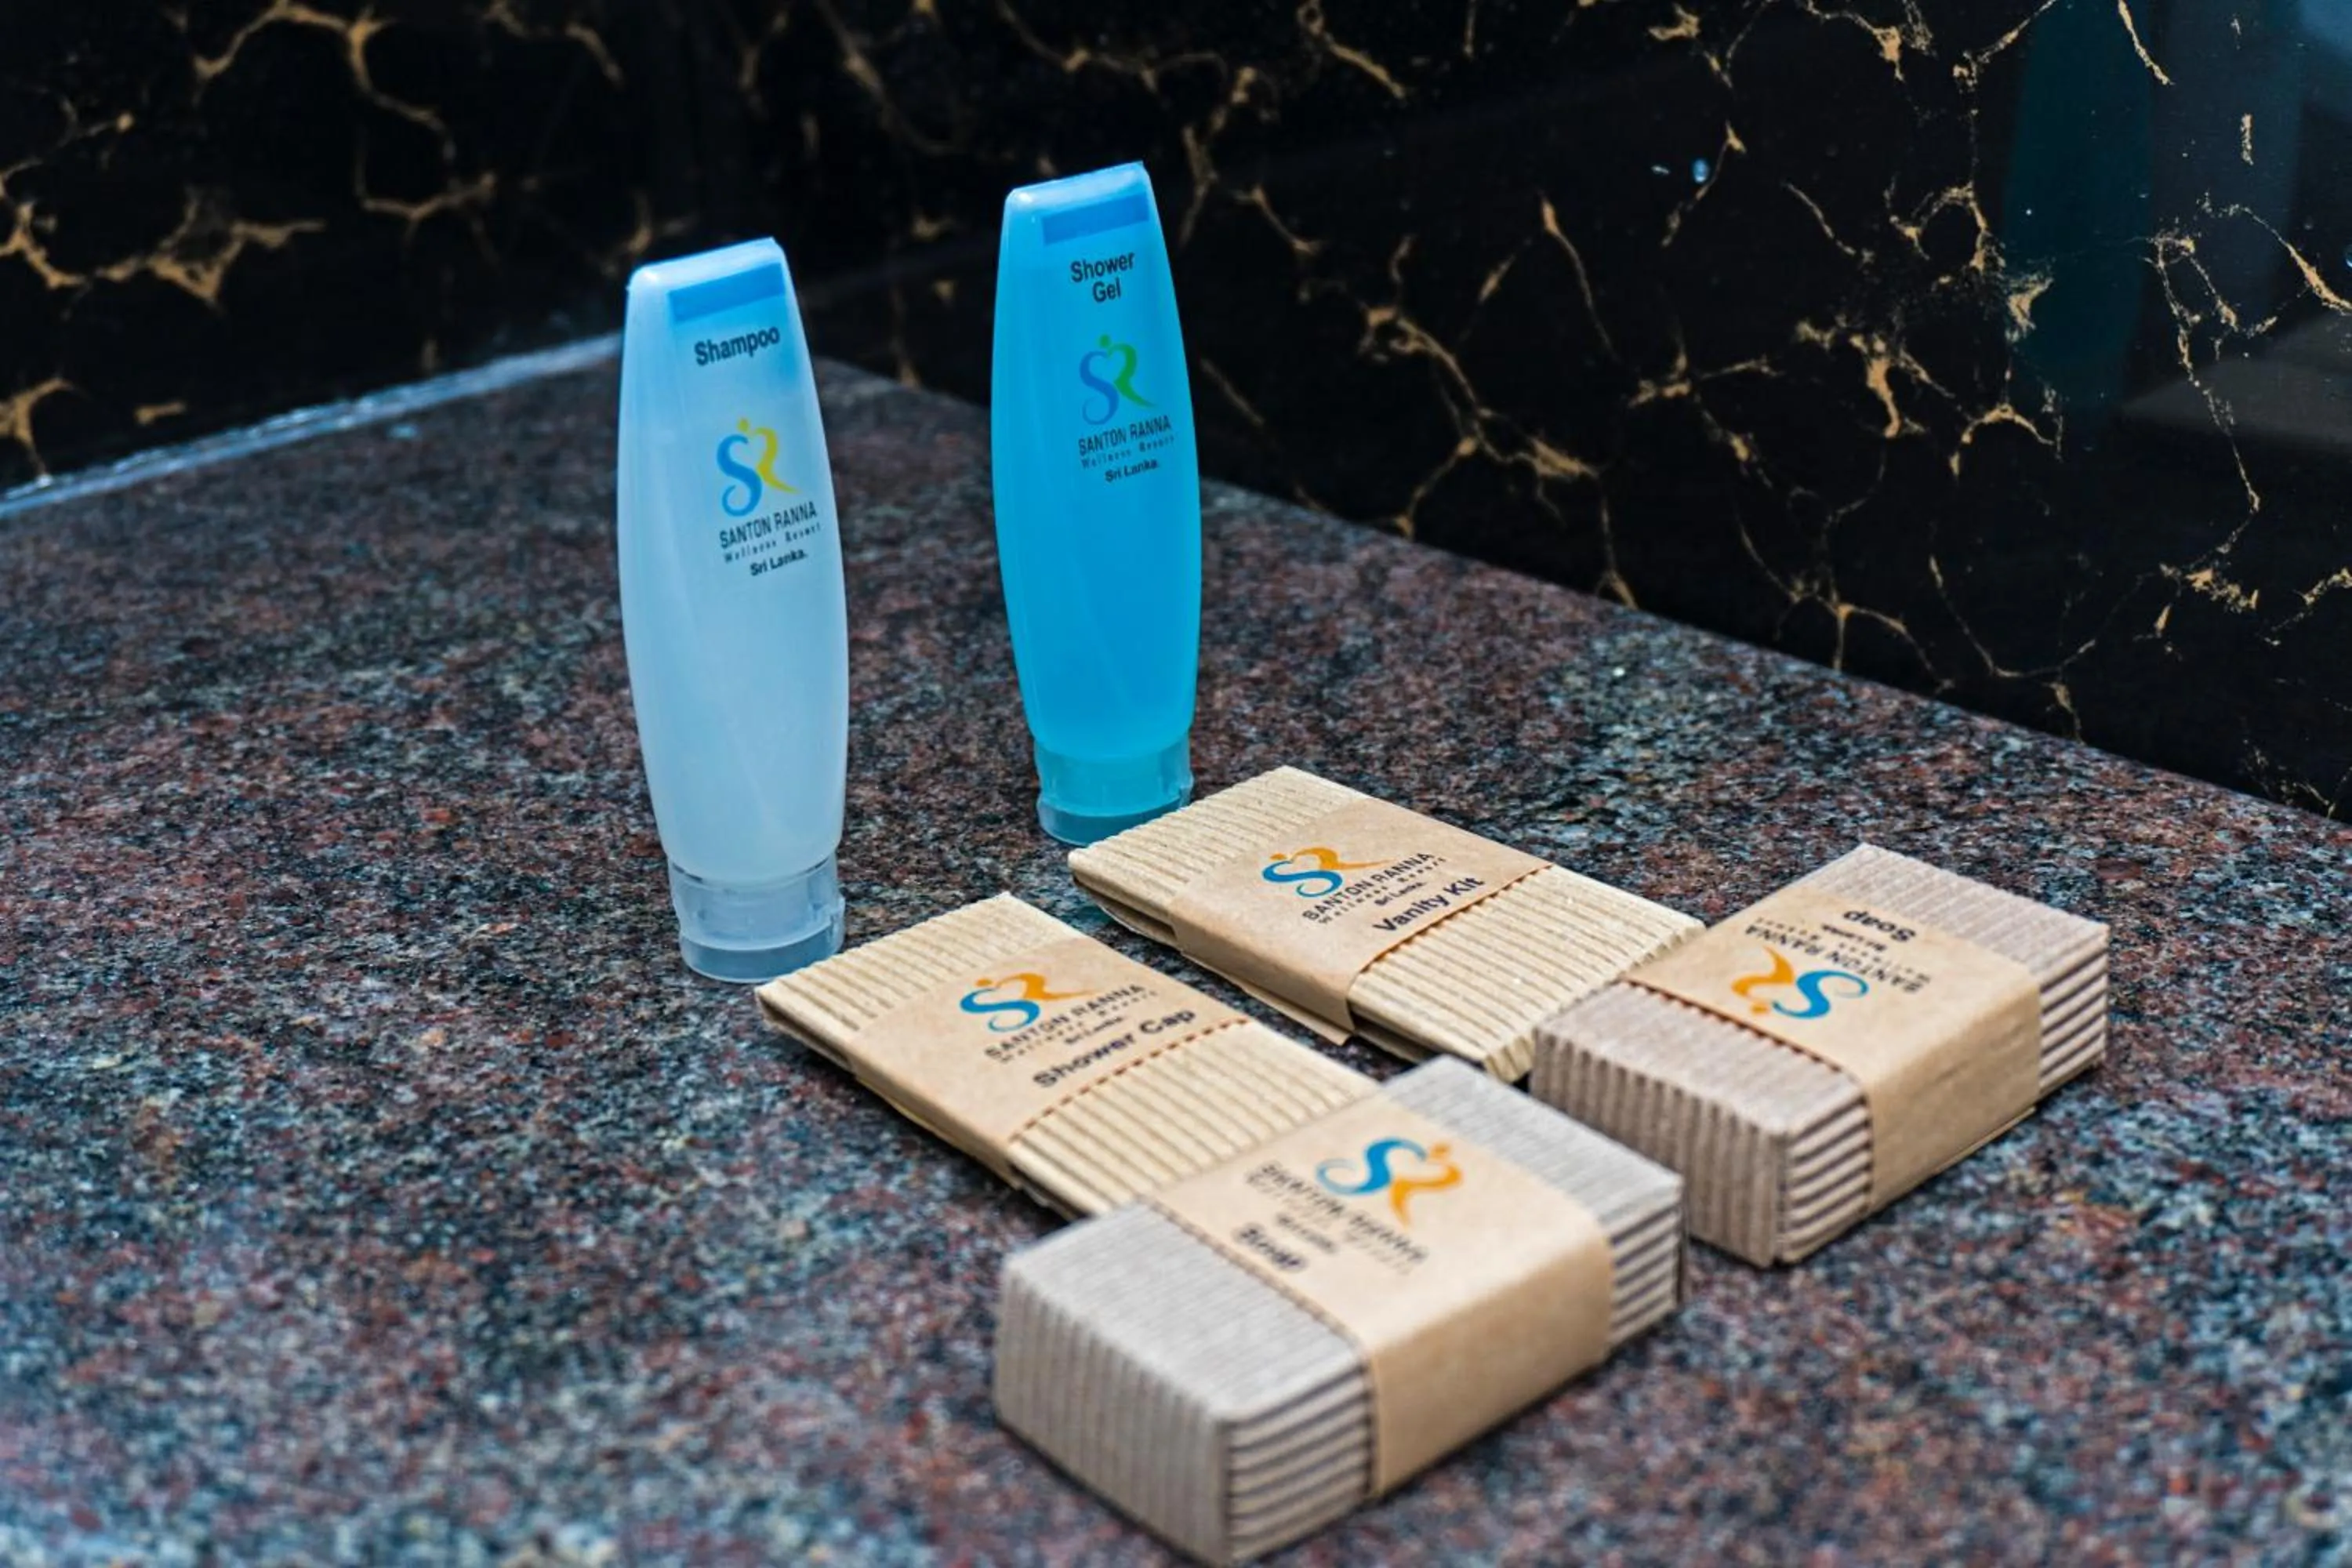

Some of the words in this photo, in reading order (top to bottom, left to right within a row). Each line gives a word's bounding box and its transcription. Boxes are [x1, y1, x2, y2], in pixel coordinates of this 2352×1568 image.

[1070, 252, 1134, 283] Shower
[1092, 278, 1121, 303] Gel
[694, 327, 780, 365] Shampoo
[1079, 427, 1127, 456] SANTON
[1130, 415, 1172, 440] RANNA
[720, 516, 771, 548] SANTON
[775, 501, 817, 532] RANNA
[750, 558, 768, 576] Sri
[1301, 880, 1372, 921] SANTON
[1371, 852, 1435, 884] RANNA
[1374, 894, 1450, 932] Vanity
[1443, 876, 1486, 897] Kit
[1843, 910, 1916, 942] Soap
[1033, 1033, 1136, 1087] Shower
[1139, 1009, 1196, 1034] Cap
